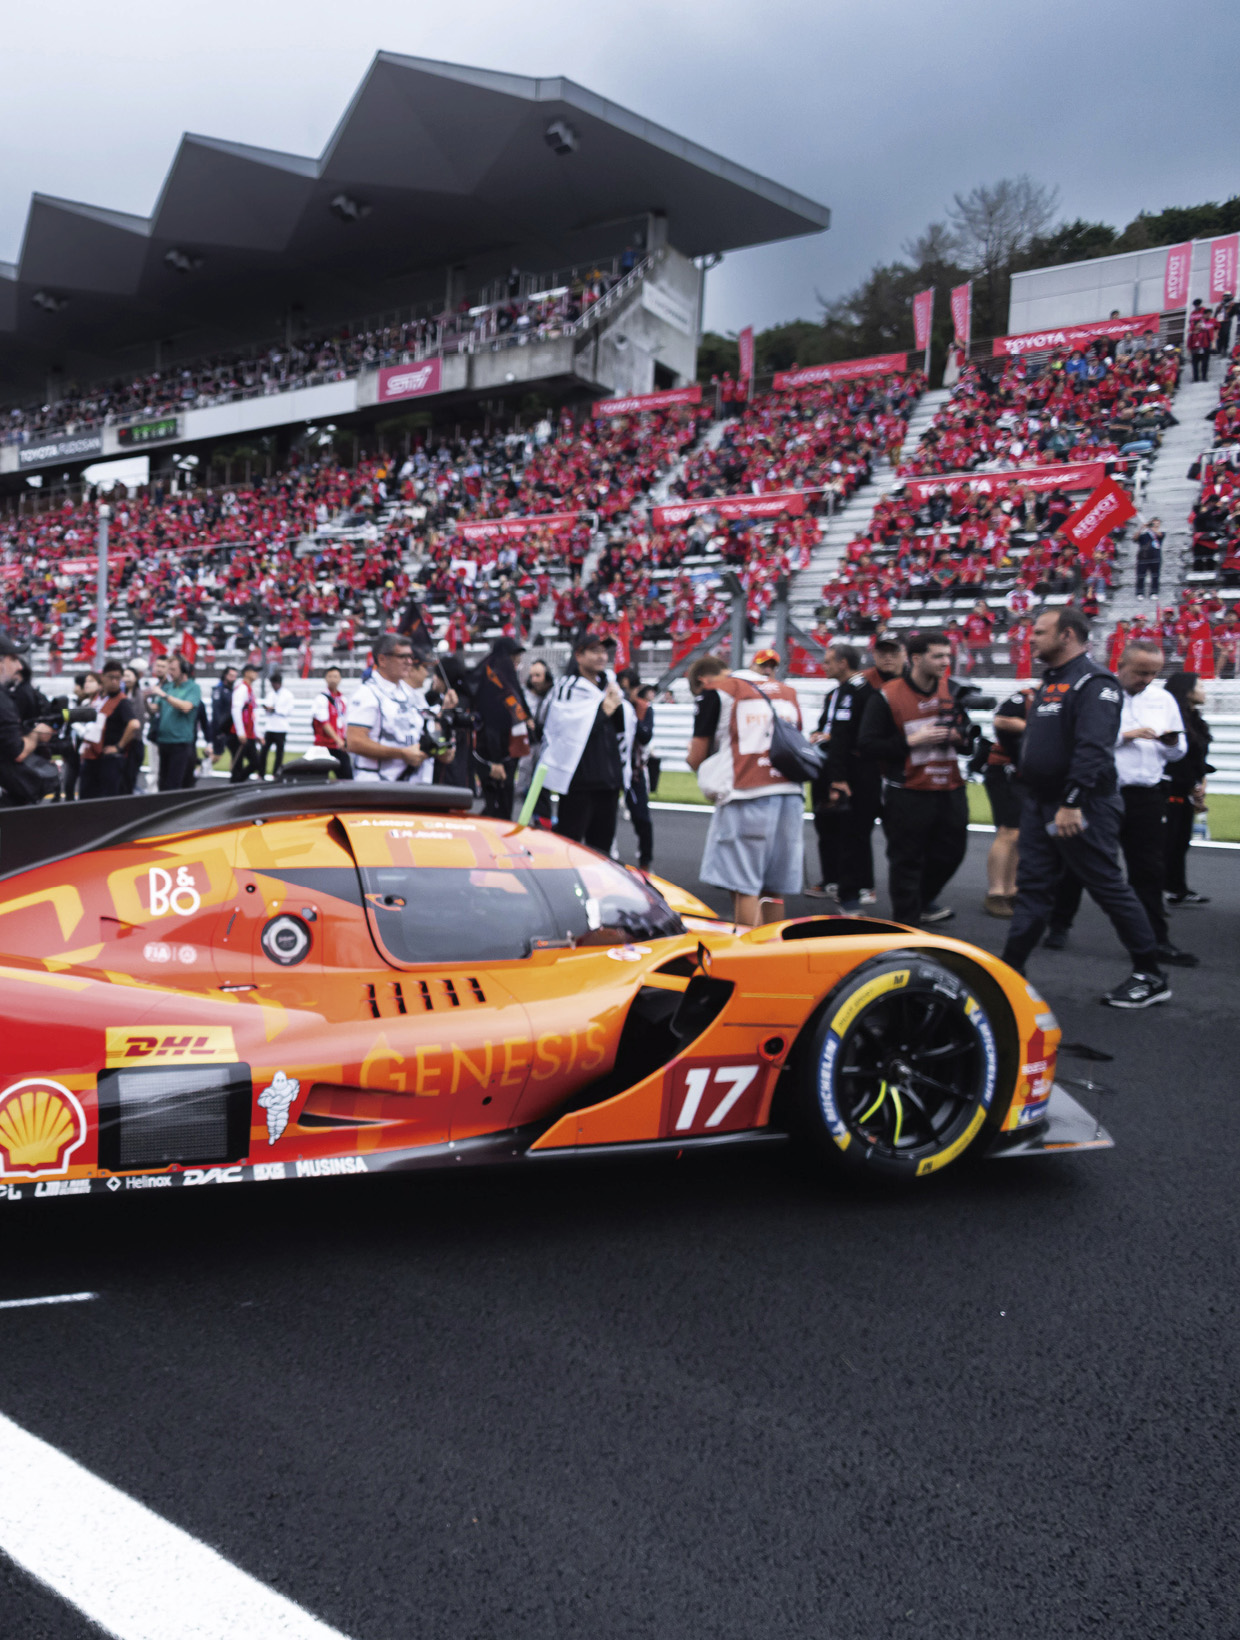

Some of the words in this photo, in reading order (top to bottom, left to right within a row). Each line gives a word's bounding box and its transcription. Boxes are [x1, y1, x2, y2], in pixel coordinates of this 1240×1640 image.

[1004, 331, 1065, 351] TOYOTA
[19, 444, 58, 463] TOYOTA
[149, 866, 201, 917] B&O
[124, 1036, 217, 1057] DHL
[359, 1022, 607, 1097] GENESIS
[819, 1038, 838, 1123] MICHELIN
[675, 1065, 759, 1131] 17
[182, 1166, 244, 1186] DAC
[295, 1156, 369, 1178] MUSINSA
[125, 1175, 172, 1190] Helinox
